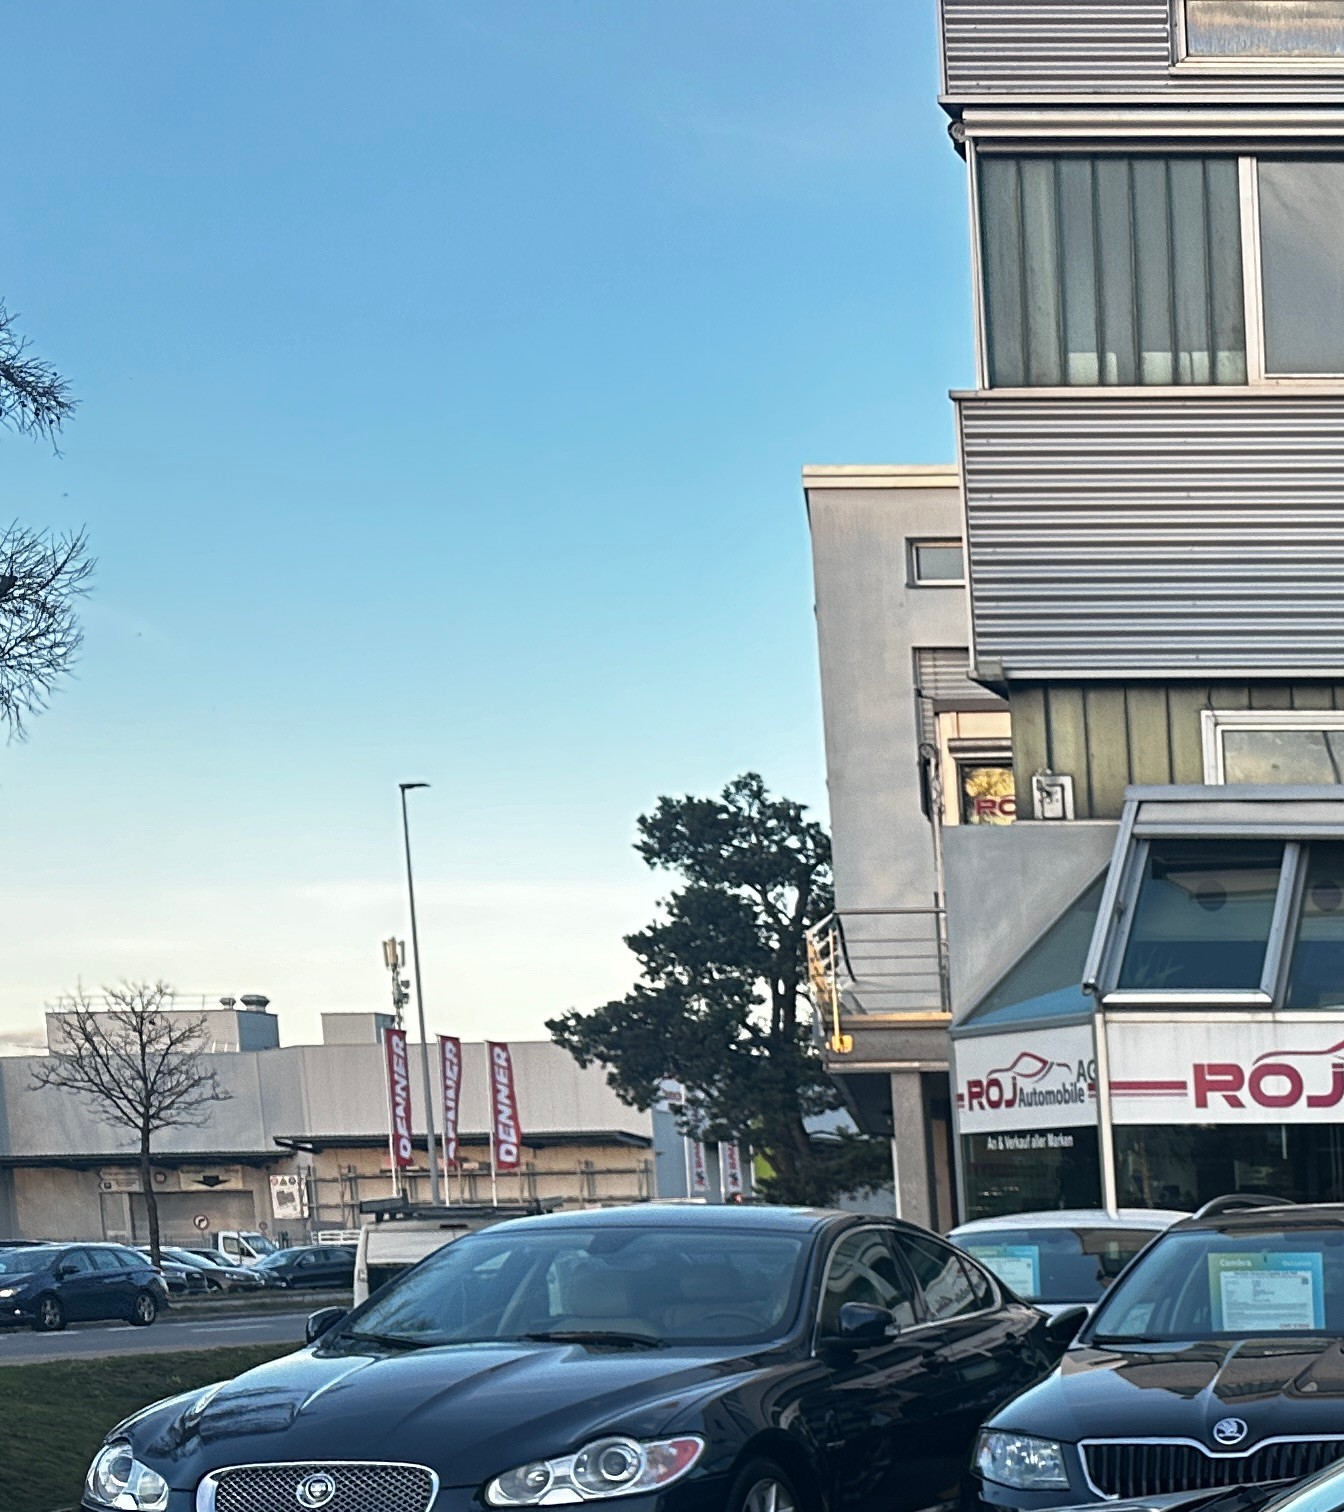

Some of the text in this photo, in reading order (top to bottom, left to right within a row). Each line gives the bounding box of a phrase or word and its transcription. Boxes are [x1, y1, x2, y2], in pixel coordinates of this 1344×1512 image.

[392, 1035, 412, 1159] DENNER
[493, 1045, 518, 1164] DENNER
[967, 1076, 1018, 1111] ROJ
[1018, 1082, 1085, 1108] Automobile
